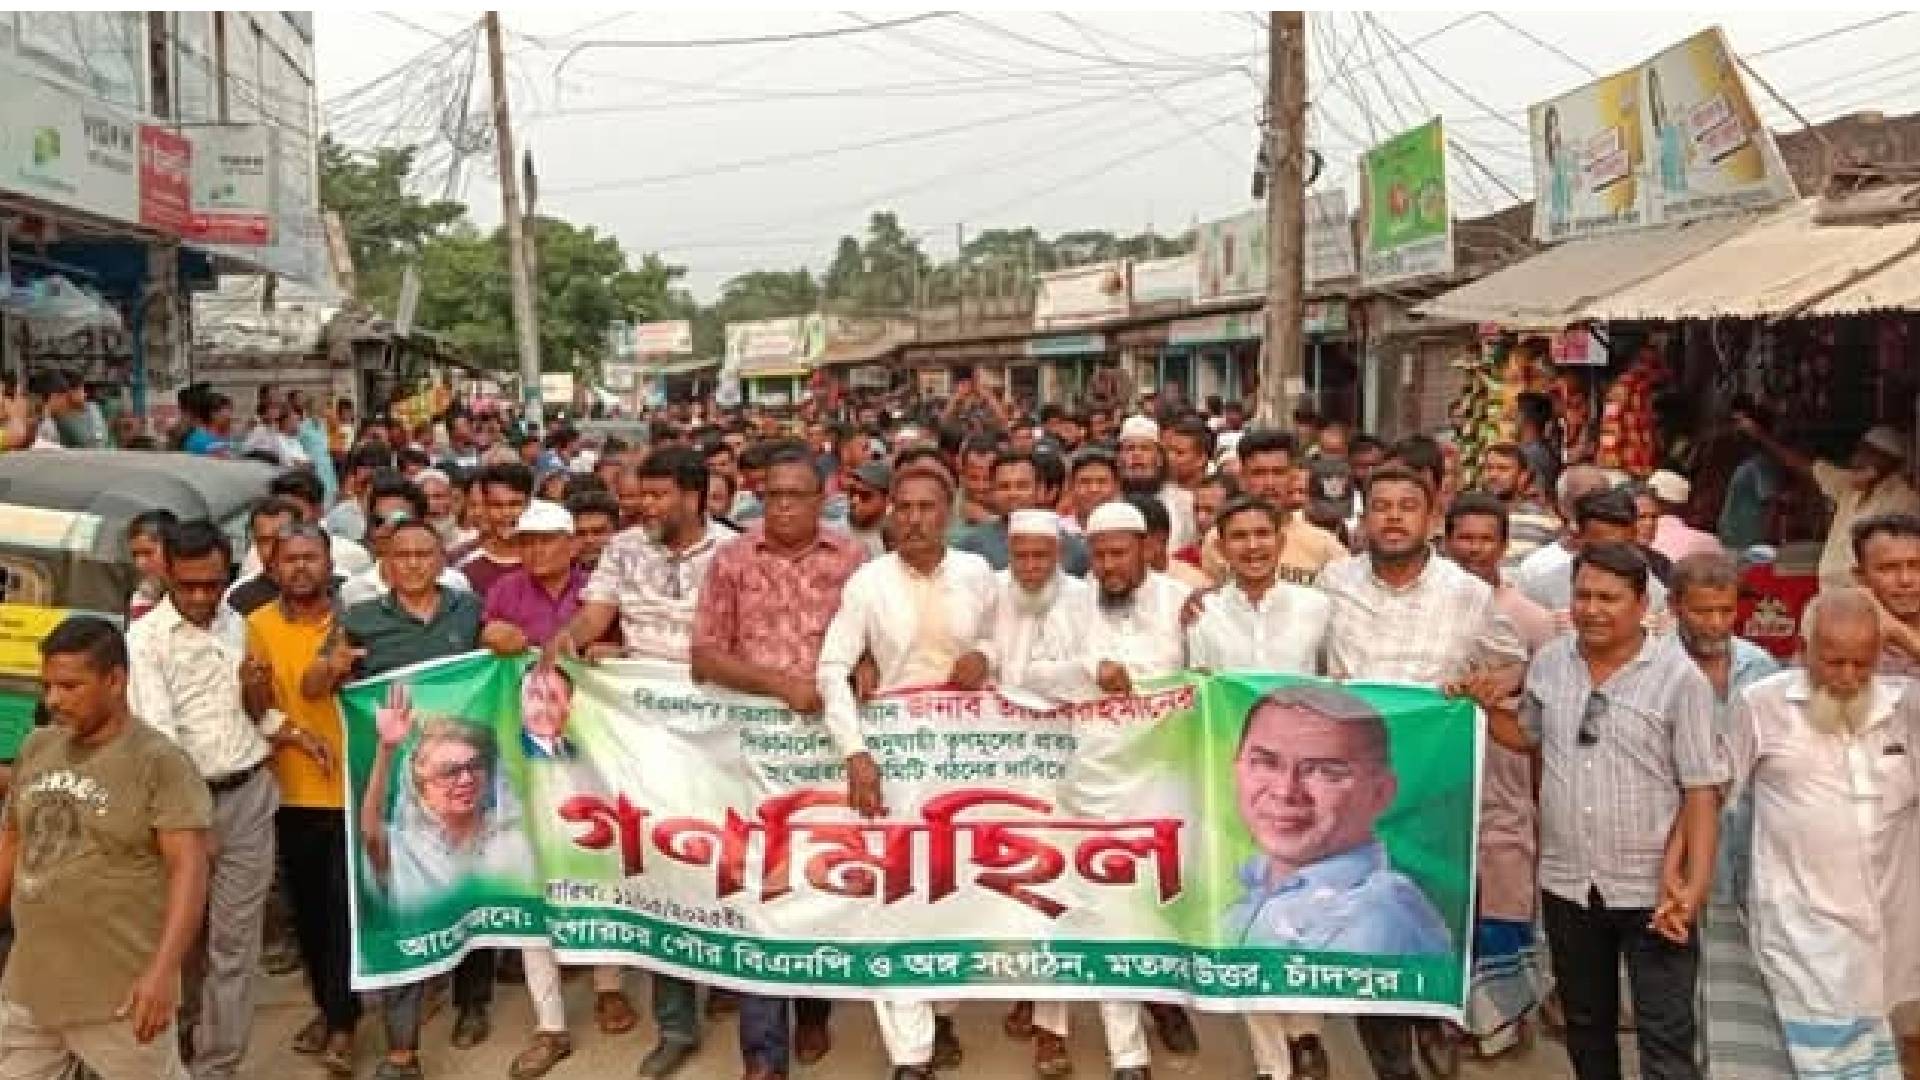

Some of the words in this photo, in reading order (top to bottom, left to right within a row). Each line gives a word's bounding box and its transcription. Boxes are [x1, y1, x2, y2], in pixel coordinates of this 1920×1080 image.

[557, 787, 1185, 919] গণমিছিল
[661, 930, 721, 967] পৌর
[732, 939, 851, 979] বিএনপি
[866, 950, 892, 978] ও
[1284, 955, 1401, 999] চাঁদপুর
